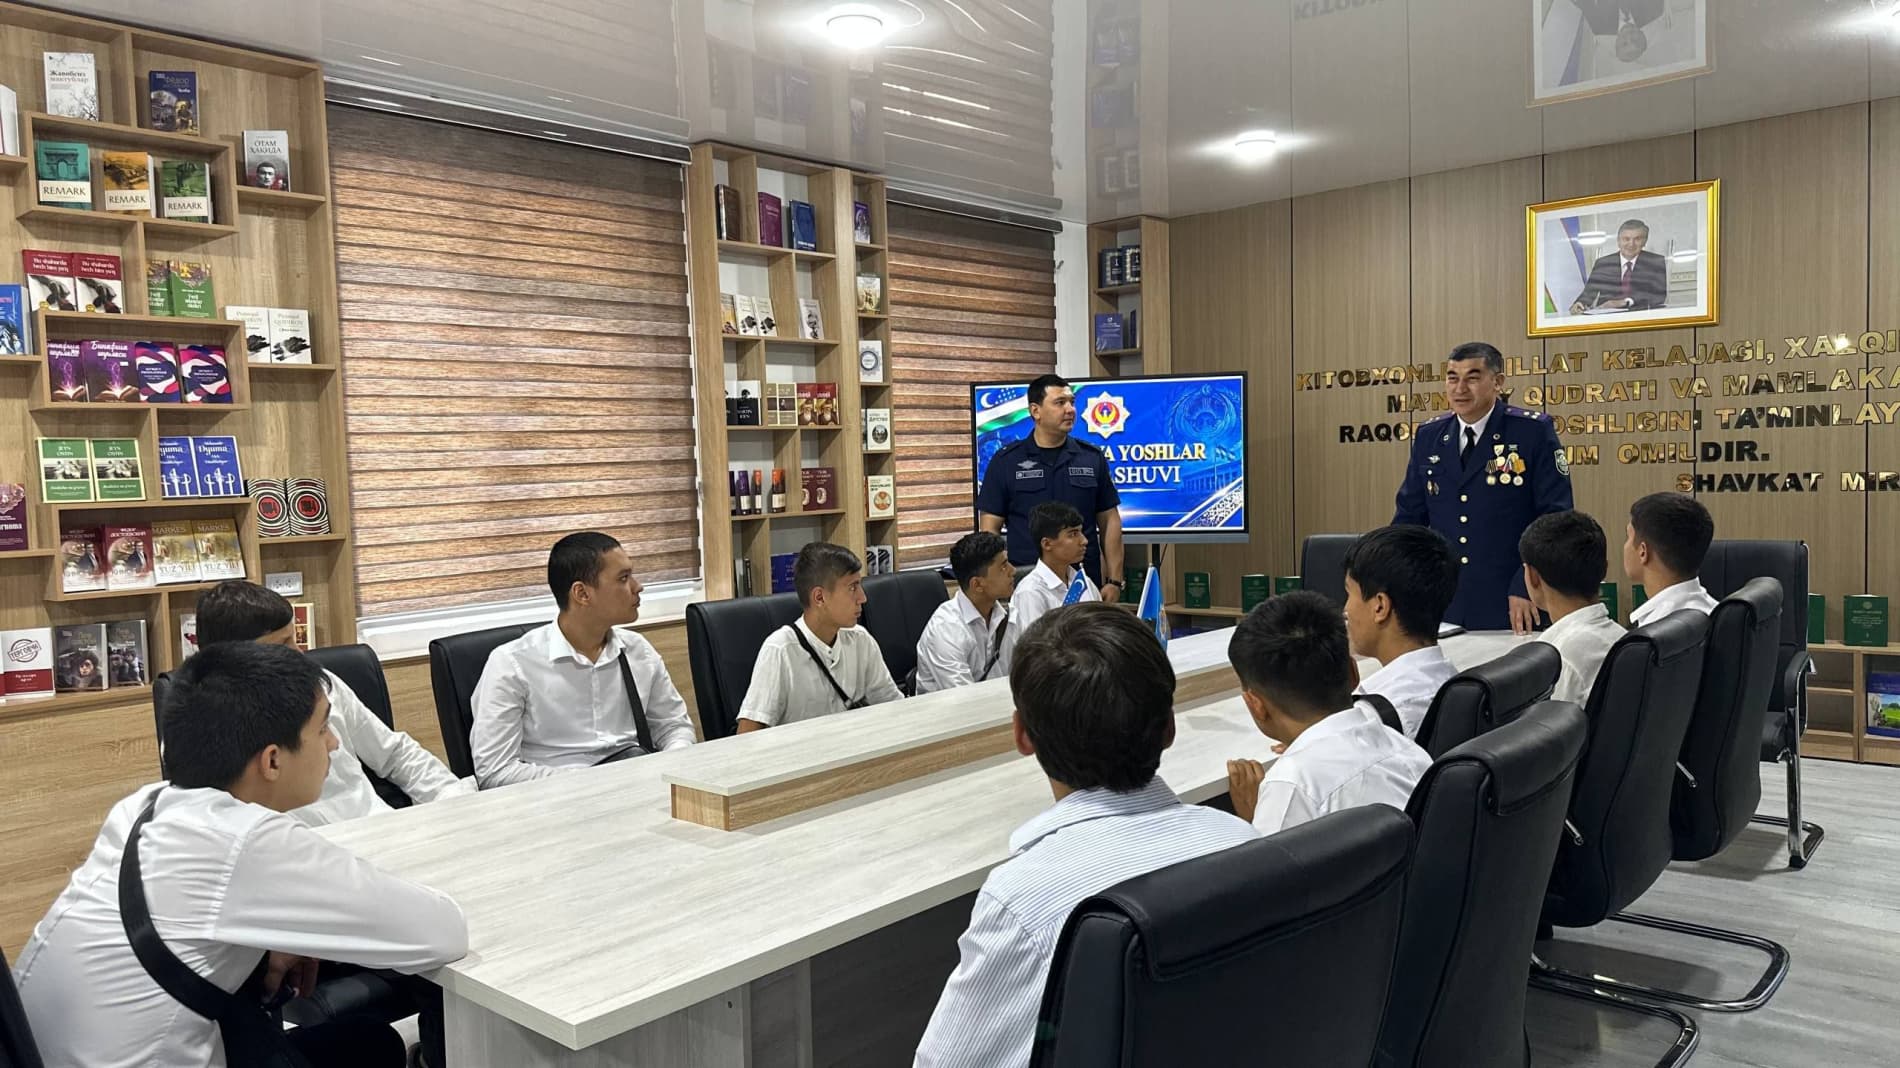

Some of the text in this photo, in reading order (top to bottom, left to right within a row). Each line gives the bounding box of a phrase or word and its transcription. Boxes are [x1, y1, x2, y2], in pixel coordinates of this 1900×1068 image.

[43, 186, 87, 196] REMARK
[109, 195, 147, 204] REMARK
[168, 202, 203, 210] REMARK
[1296, 329, 1900, 392] KITOBXONLI ILLAT KELAJAGI, XALQI
[1523, 379, 1657, 406] QUDRATI
[1670, 376, 1712, 399] VA
[1118, 443, 1206, 461] YOSHLAR
[1112, 465, 1181, 484] SHUVI
[1676, 472, 1824, 493] SHAVKAT
